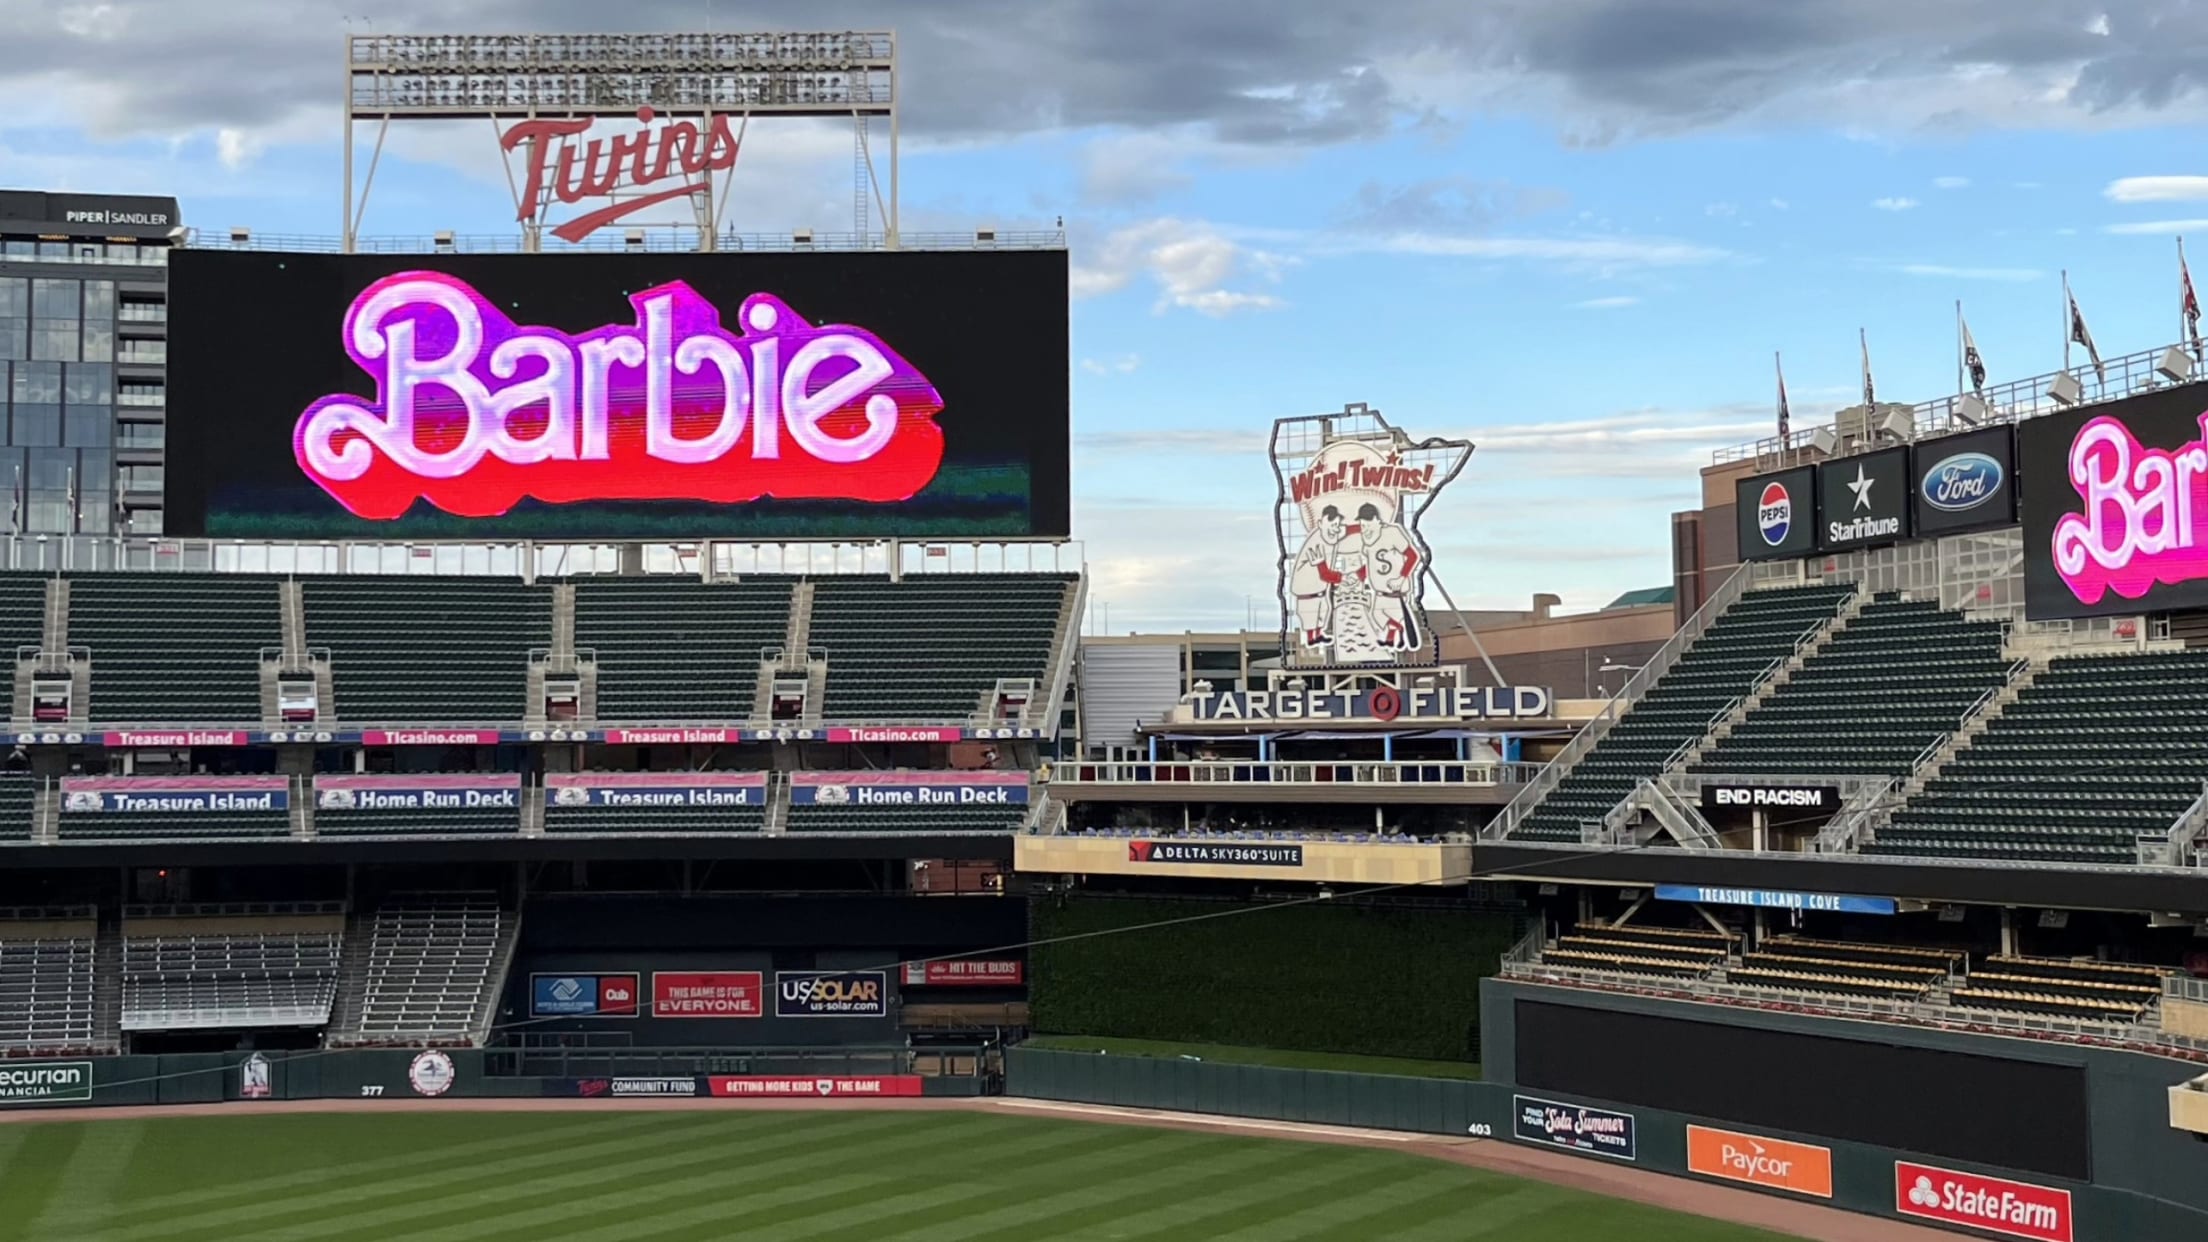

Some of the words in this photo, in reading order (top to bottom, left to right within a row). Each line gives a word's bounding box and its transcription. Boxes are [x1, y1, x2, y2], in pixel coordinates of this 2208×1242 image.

[501, 106, 737, 222] Twins
[66, 210, 104, 223] PIPER
[111, 212, 168, 225] SANDLER
[303, 279, 899, 481] Barbie
[1289, 461, 1347, 503] Win!
[1349, 458, 1434, 491] Twins!
[1937, 463, 1986, 501] Ford
[2055, 422, 2208, 576] Bar
[1760, 506, 1789, 522] PEPSI
[1196, 689, 1361, 720] TARGET
[1410, 687, 1548, 718] FIELD
[119, 732, 185, 745] Treasure
[188, 732, 233, 745] Island
[620, 730, 680, 743] Treasure
[683, 730, 726, 743] Island
[114, 794, 204, 810] Treasure
[209, 793, 272, 810] Island
[360, 791, 418, 808] Home
[423, 791, 460, 807] Run
[465, 789, 514, 807] Deck
[600, 789, 685, 805] Treasure
[689, 788, 747, 805] Island
[858, 787, 914, 804] Home
[918, 787, 955, 804] Run
[961, 786, 1008, 803] Deck
[1715, 788, 1753, 805] END
[1754, 789, 1822, 806] RACISM
[1166, 847, 1208, 859] DELTA
[1698, 888, 1754, 905] TREASURE
[1760, 891, 1802, 908] ISLAND
[1809, 895, 1841, 910] COVE
[949, 962, 965, 974] HIT
[968, 962, 986, 974] THE
[988, 962, 1016, 974] BUDS
[668, 987, 689, 998] THIS
[690, 987, 716, 998] GAME
[717, 987, 726, 998] IS
[727, 987, 745, 998] FOR
[659, 999, 756, 1011] EVERYONE.
[0, 1069, 80, 1086] ecurian
[361, 1086, 385, 1096] 377
[611, 1081, 668, 1092] COMMUNITY
[670, 1081, 696, 1092] FUND
[726, 1081, 764, 1092] GETTING
[765, 1081, 790, 1092] MORE
[792, 1081, 814, 1092] KIDS
[836, 1080, 853, 1092] THE
[855, 1081, 881, 1092] GAME
[1525, 1106, 1544, 1117] FIND
[1468, 1122, 1491, 1136] 403
[1522, 1115, 1544, 1127] YOUR
[1574, 1109, 1625, 1135] Summer
[1592, 1132, 1627, 1147] TICKETS
[1721, 1144, 1793, 1178] Paycor
